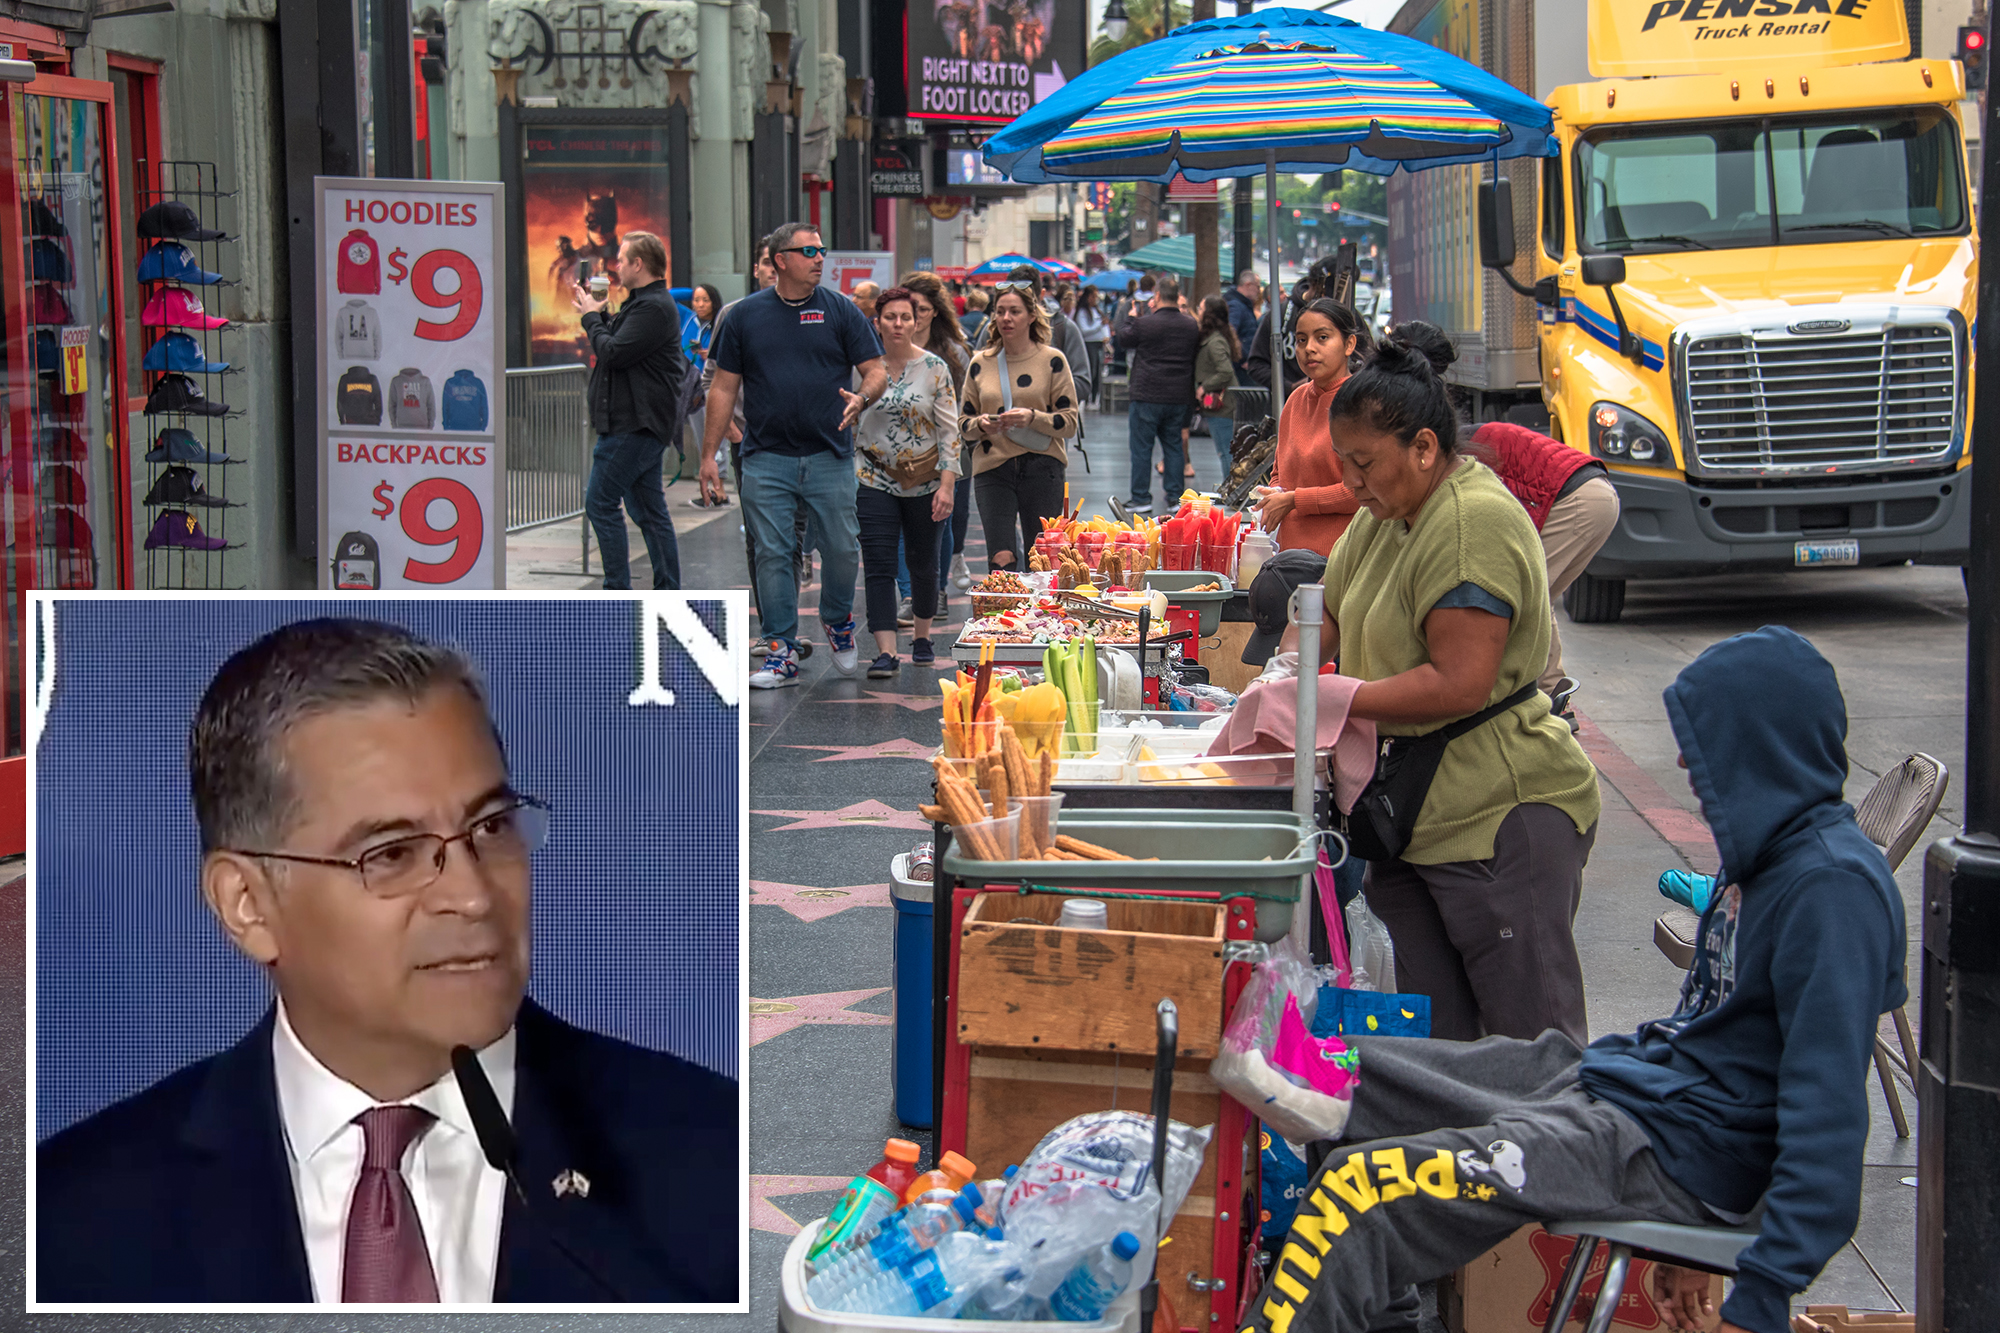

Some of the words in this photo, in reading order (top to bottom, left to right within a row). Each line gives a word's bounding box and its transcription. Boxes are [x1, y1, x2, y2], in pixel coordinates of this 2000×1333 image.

[1694, 24, 1753, 41] Truck
[1758, 20, 1831, 37] Rental
[922, 56, 970, 82] RIGHT
[971, 60, 1008, 86] NEXT
[1009, 62, 1030, 87] TO
[922, 85, 968, 112] FOOT
[969, 87, 1031, 115] LOCKER
[905, 117, 925, 135] TCL
[527, 140, 556, 151] TCL
[873, 157, 905, 168] TCL
[871, 172, 922, 184] CHINESE
[872, 184, 923, 194] THEATRES
[345, 199, 478, 227] HOODIES
[834, 258, 852, 266] LESS
[855, 257, 876, 266] THAN
[349, 314, 368, 339] LA
[800, 313, 825, 321] FIRE
[337, 443, 486, 466] BACKPACKS
[1240, 1147, 1460, 1333] PEANUT
